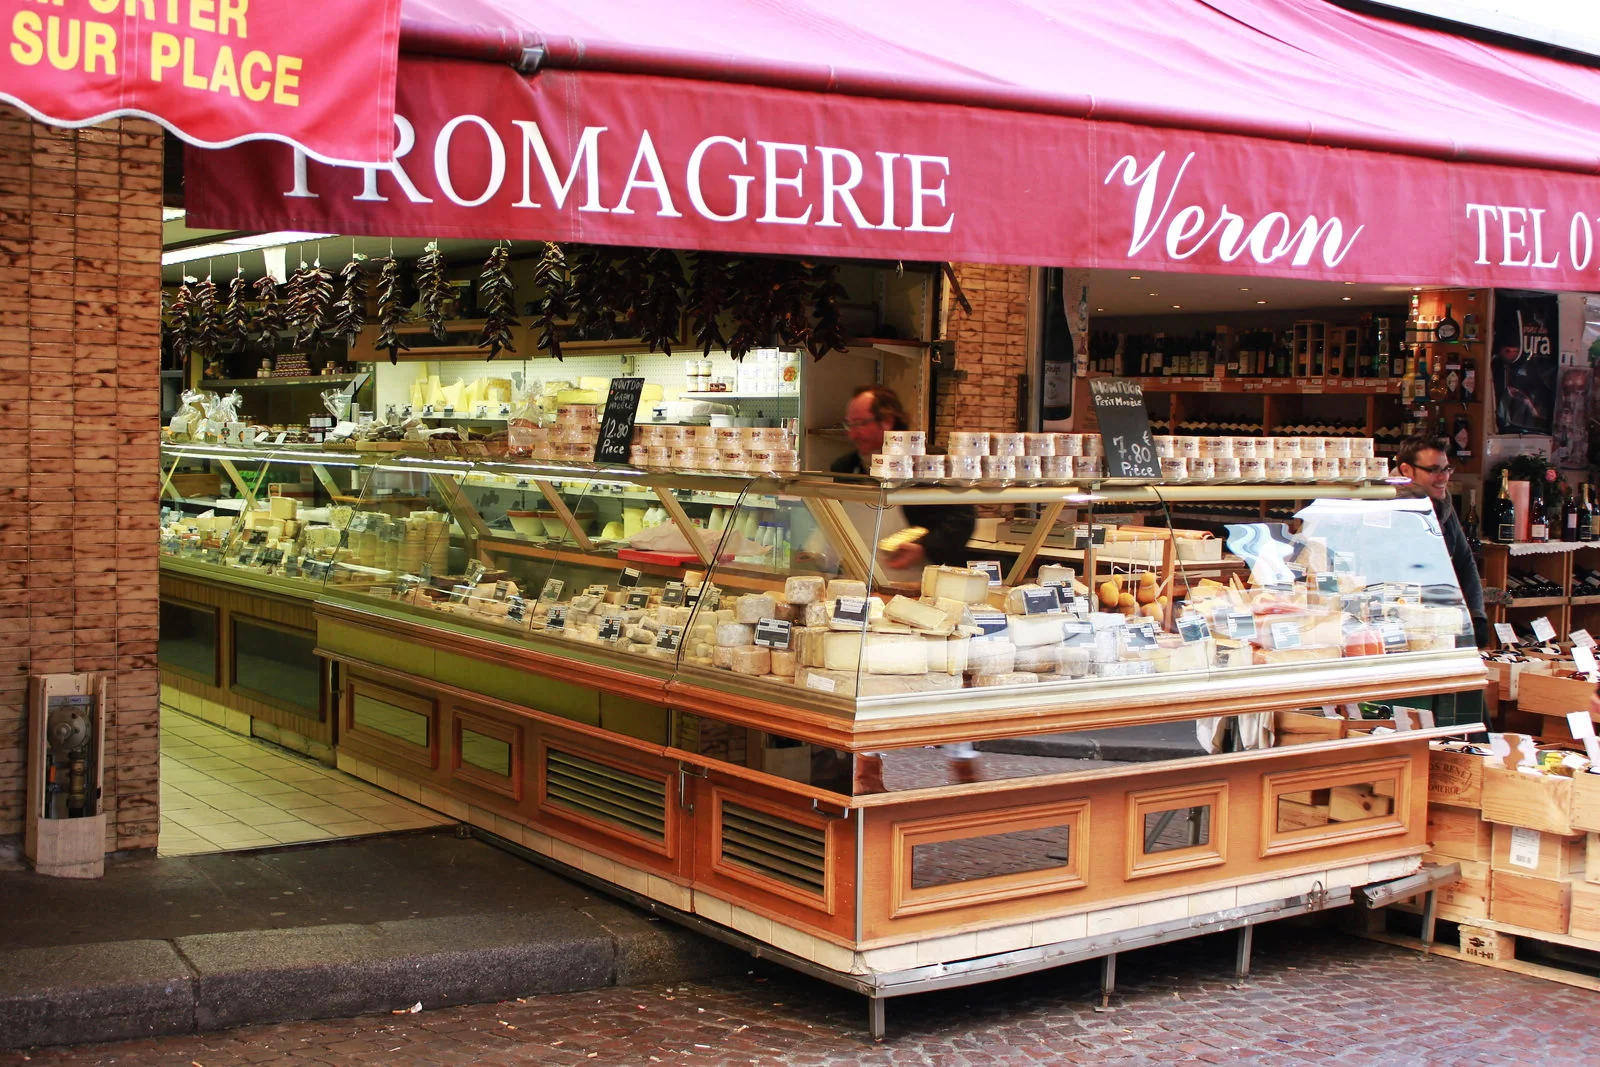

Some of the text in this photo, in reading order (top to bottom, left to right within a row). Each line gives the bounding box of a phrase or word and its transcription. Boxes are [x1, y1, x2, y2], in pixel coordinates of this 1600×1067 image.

[10, 10, 304, 107] SUR PLACE
[1104, 150, 1365, 268] Veron
[1465, 203, 1560, 269] TEL
